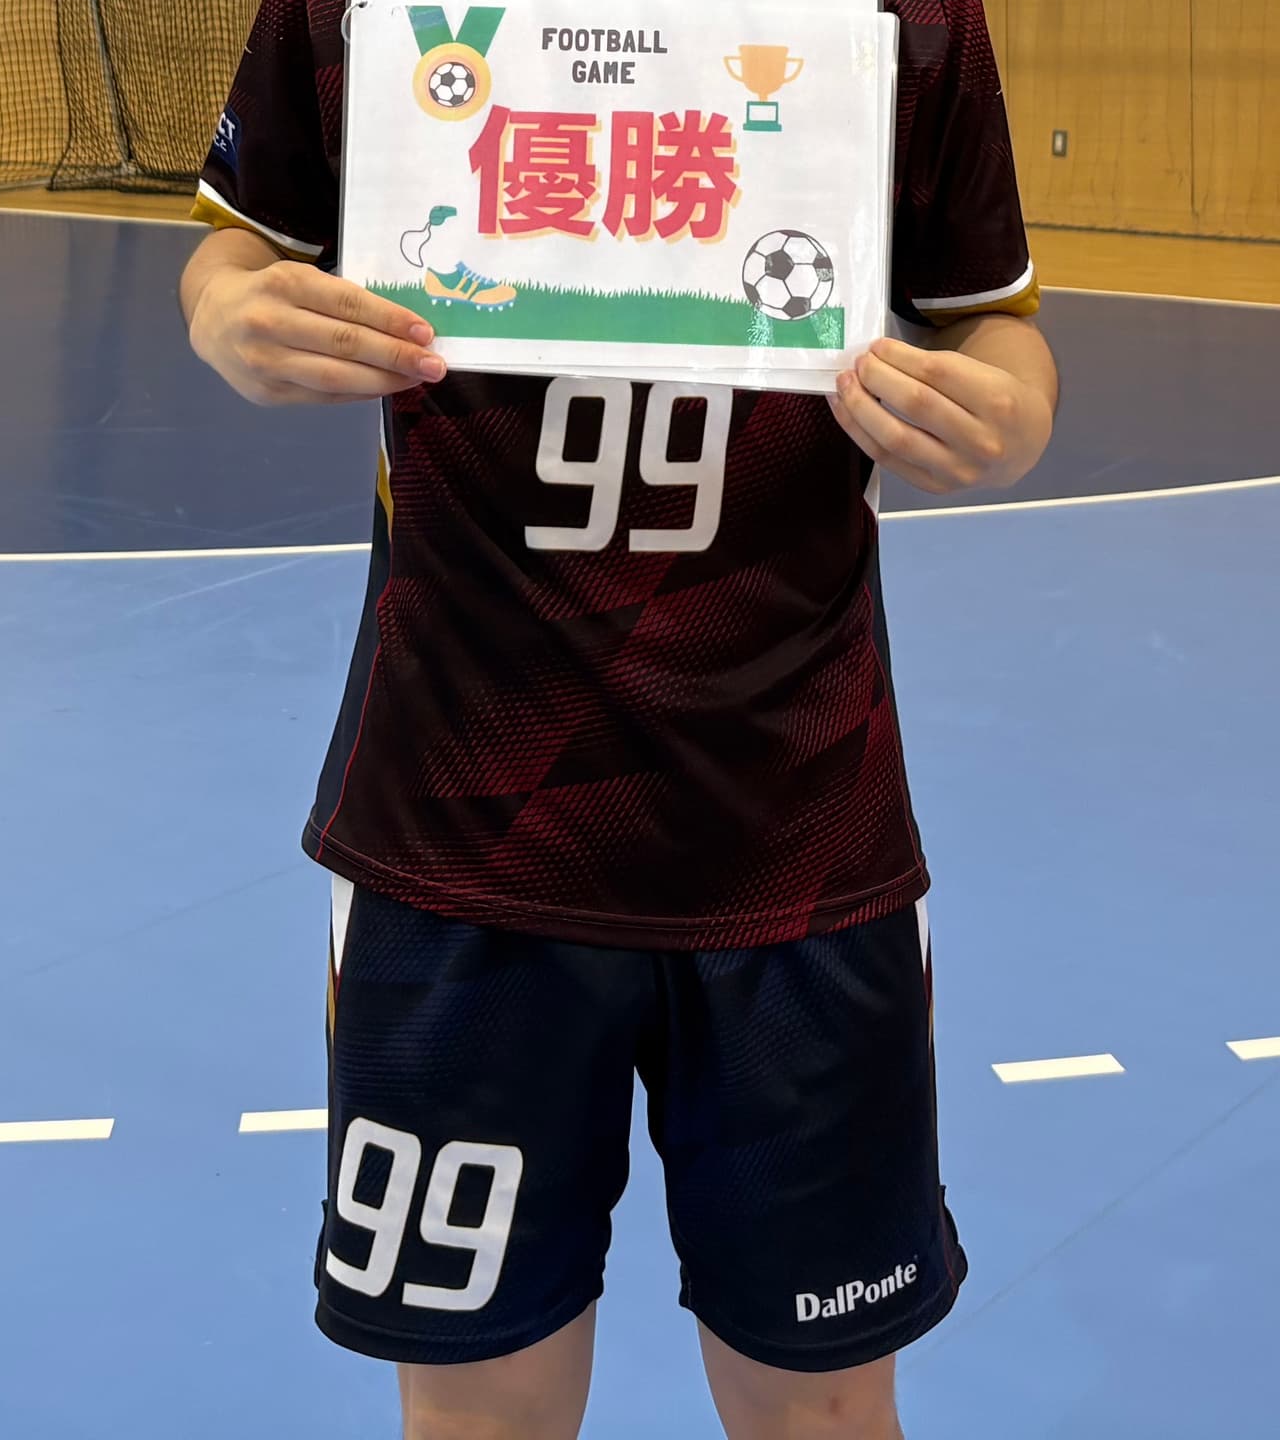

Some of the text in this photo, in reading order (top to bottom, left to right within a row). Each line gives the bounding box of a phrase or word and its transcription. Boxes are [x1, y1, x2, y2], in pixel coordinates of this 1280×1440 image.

[541, 27, 668, 54] FOOTBALL
[572, 60, 636, 85] GAME
[468, 104, 740, 242] 優勝
[524, 376, 732, 553] 99
[325, 1115, 525, 1312] 99
[795, 1259, 918, 1324] DalPonte
